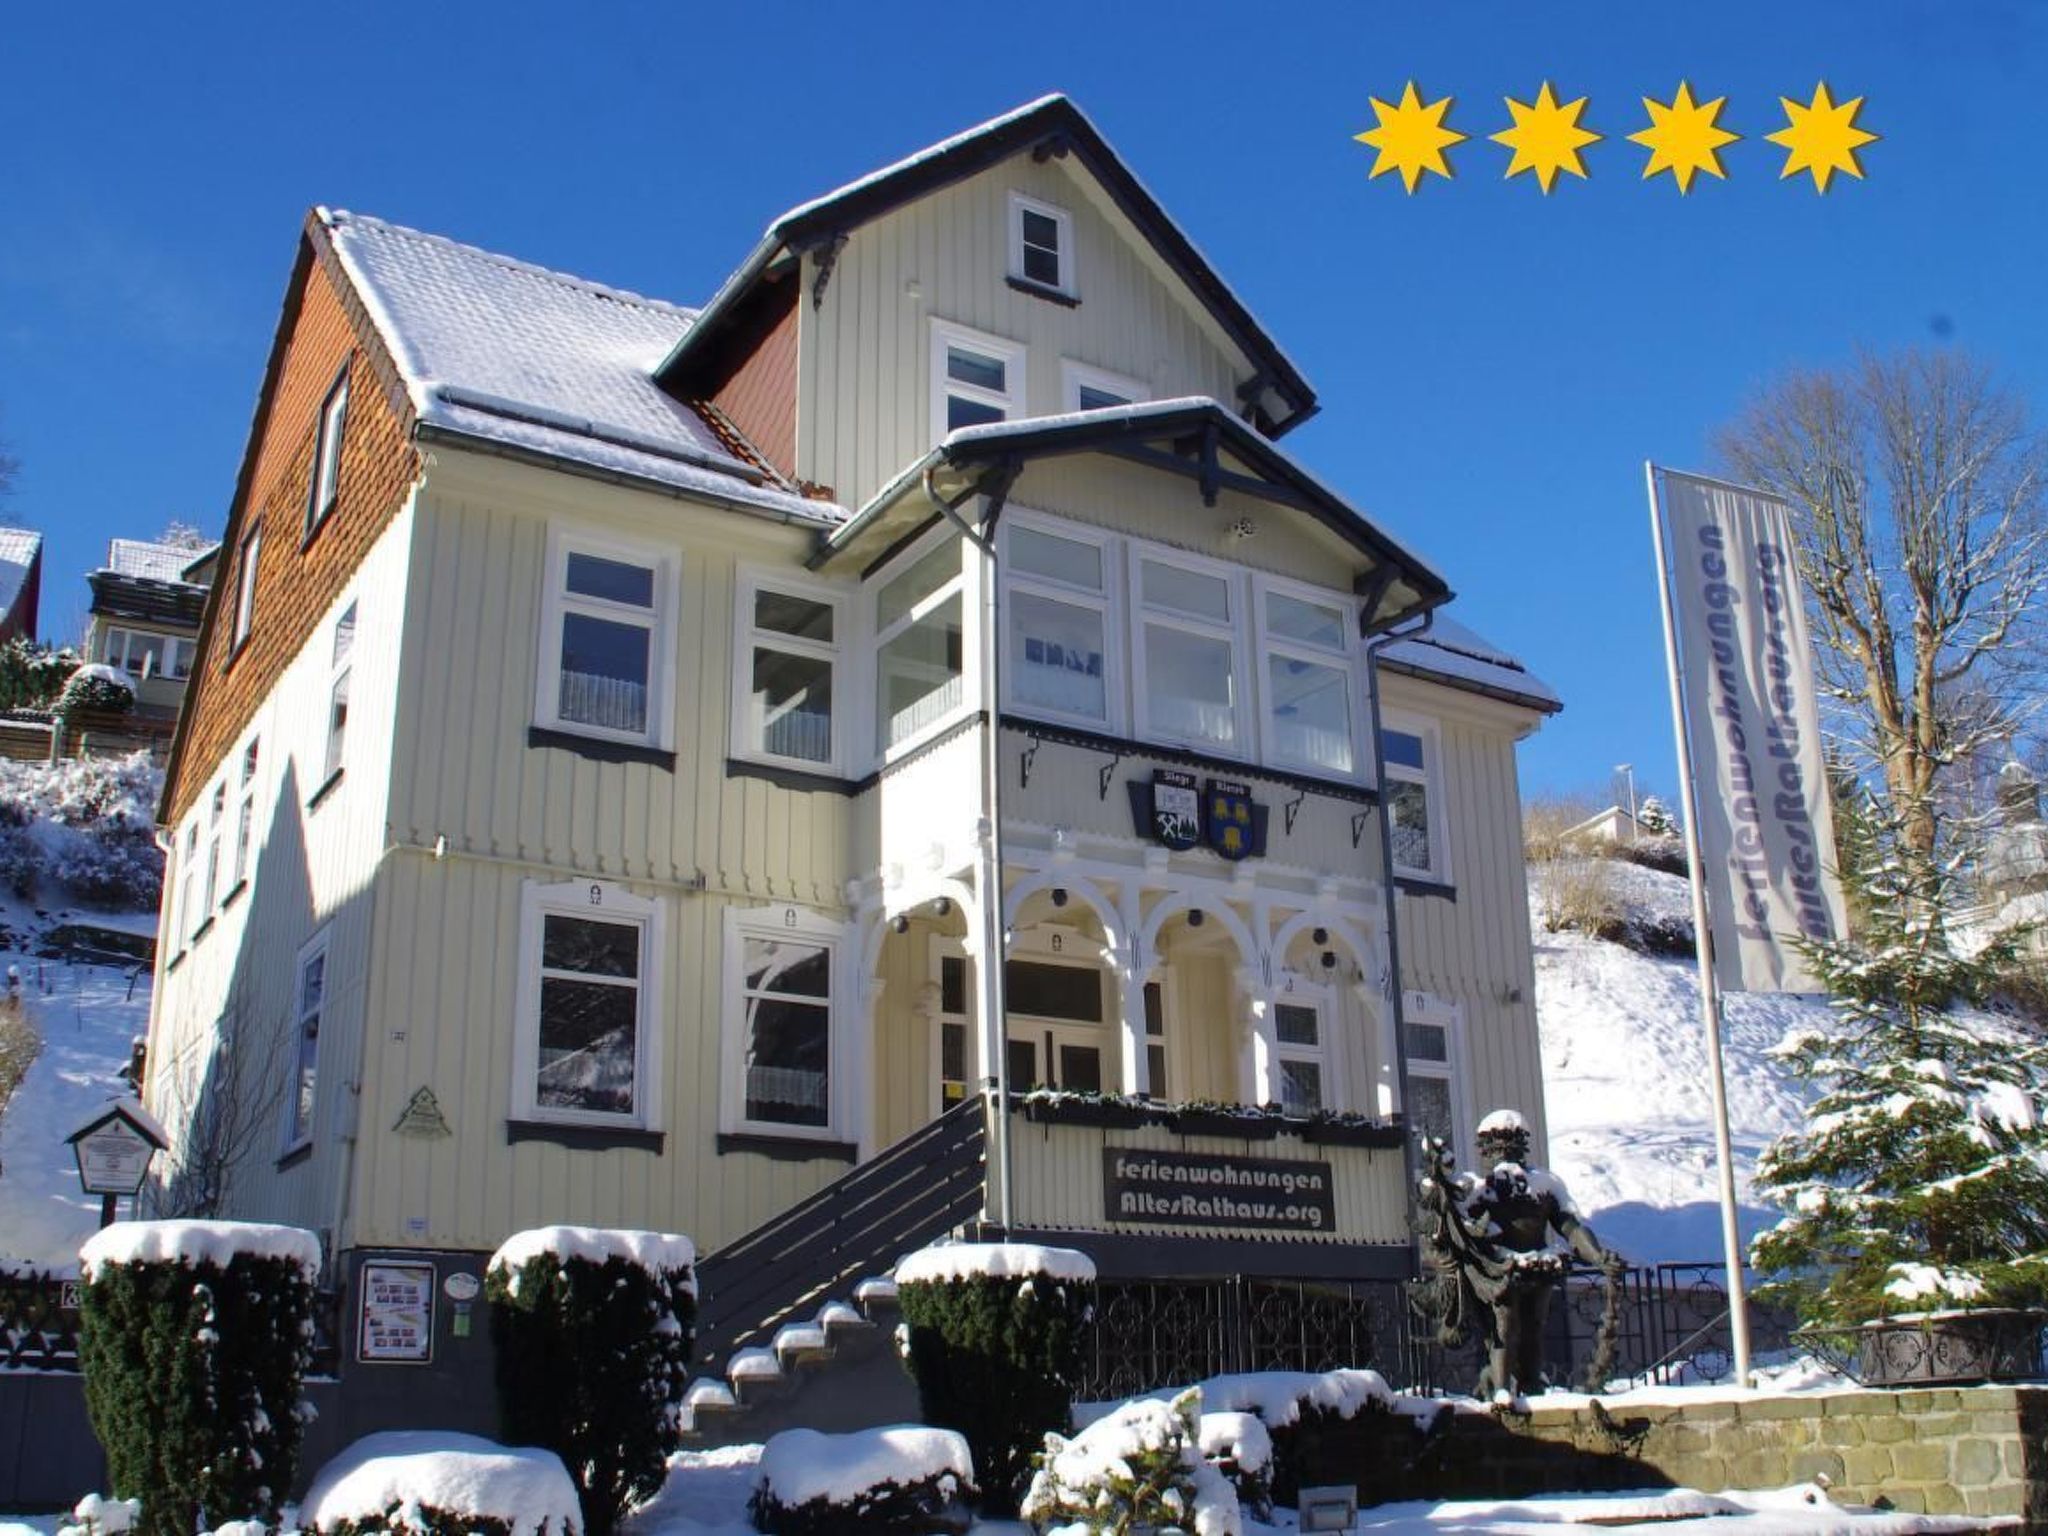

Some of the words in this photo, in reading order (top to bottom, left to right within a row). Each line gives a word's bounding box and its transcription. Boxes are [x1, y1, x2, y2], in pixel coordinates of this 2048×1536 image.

[1698, 525, 1771, 940] ferienwohnungen
[1754, 543, 1828, 938] AltesRathaus.org
[1116, 1158, 1323, 1193] ferienwohnungen
[1120, 1192, 1323, 1227] AltesRathaus.org
